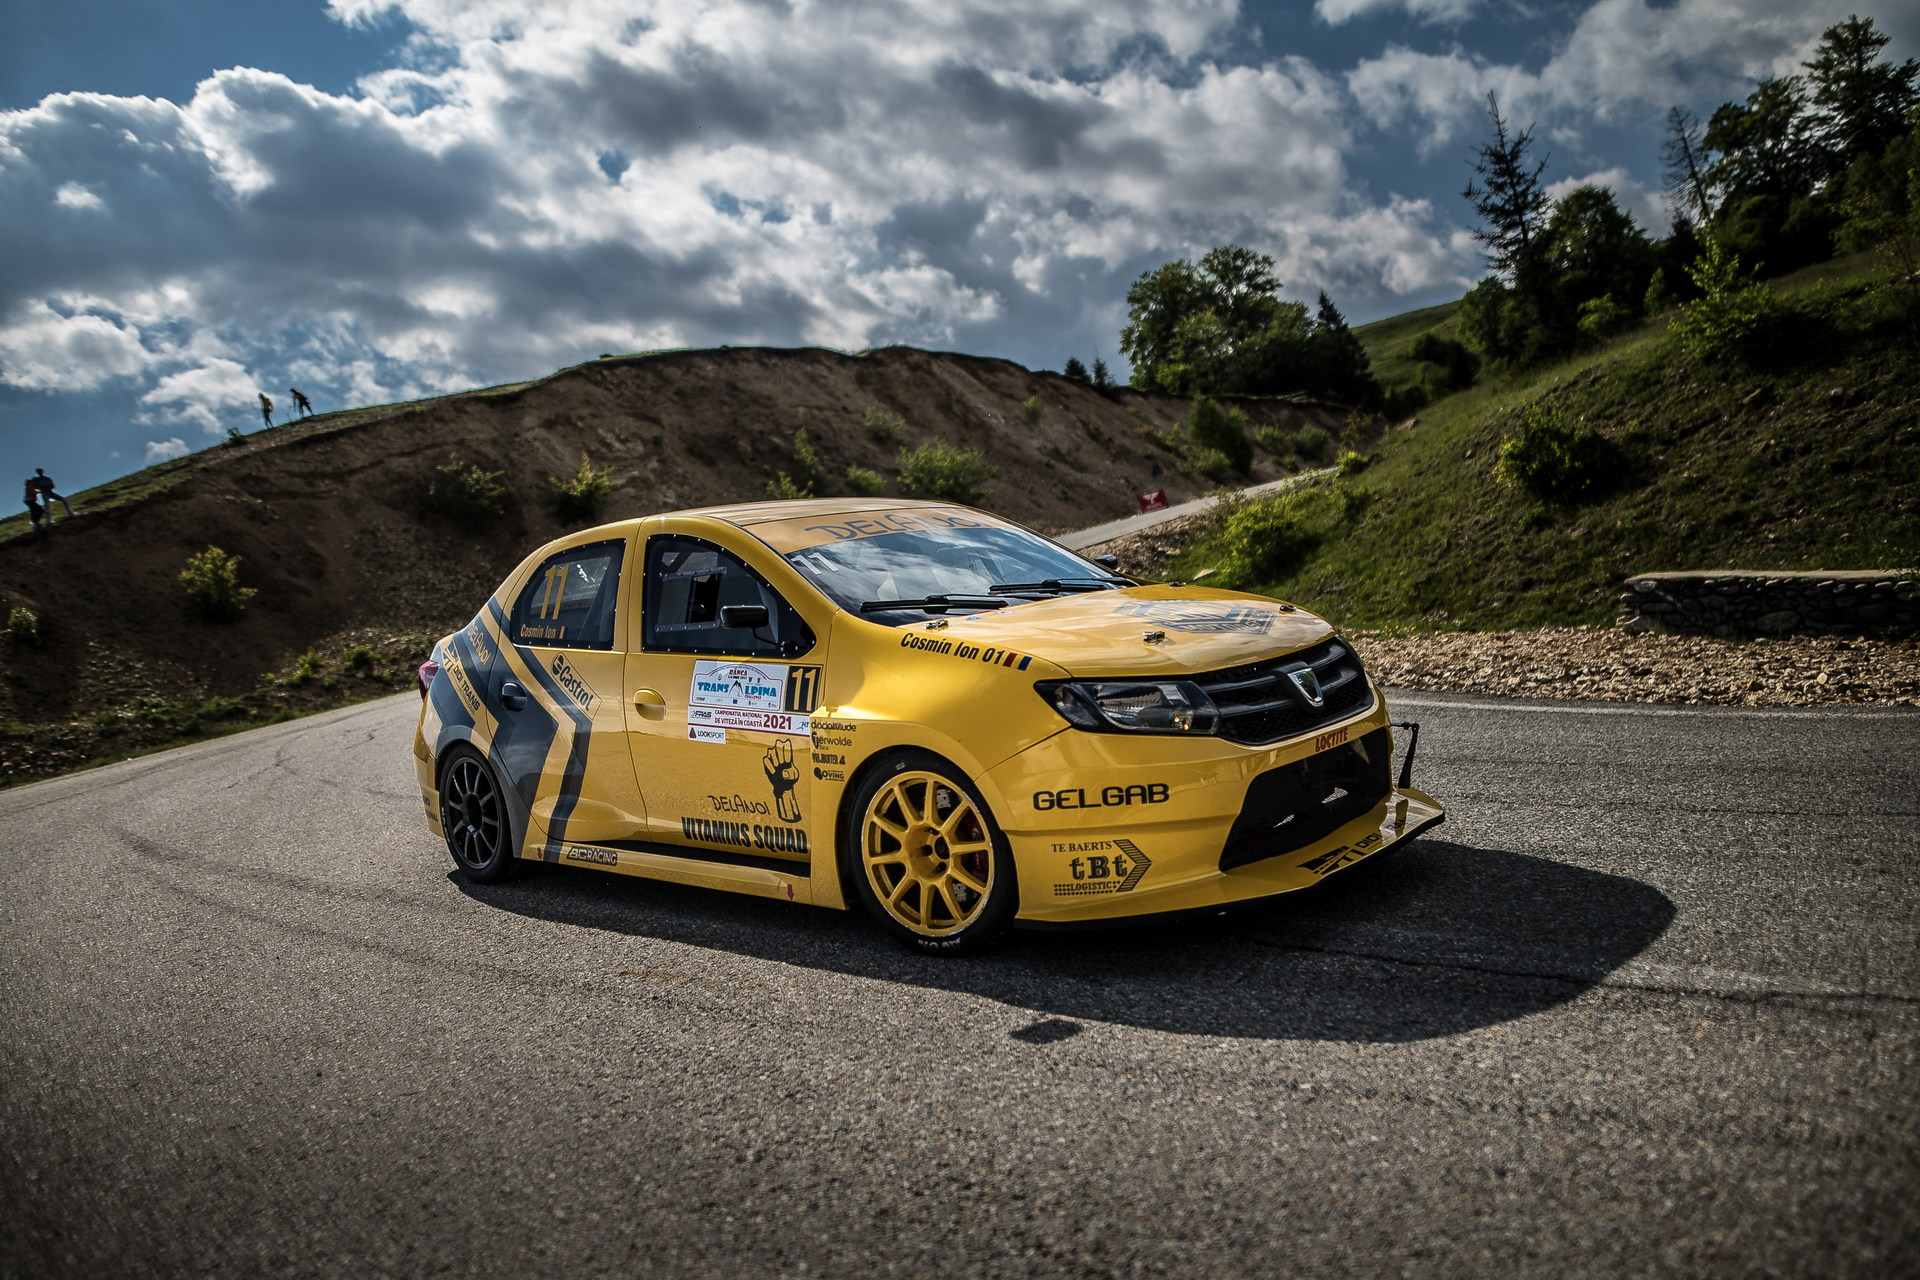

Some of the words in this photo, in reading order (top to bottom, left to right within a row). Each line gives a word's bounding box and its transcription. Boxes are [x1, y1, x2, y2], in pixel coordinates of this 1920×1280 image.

[791, 552, 839, 576] 11
[540, 564, 570, 620] 11
[520, 623, 544, 638] Cosmin
[545, 625, 557, 639] Ion
[900, 633, 952, 655] Cosmin
[953, 642, 980, 660] Ion
[462, 680, 481, 711] TRANS
[559, 665, 594, 711] Castrol
[792, 668, 817, 711] 11
[714, 709, 741, 717] CAMPIONATUL
[763, 714, 792, 730] 2021
[1315, 727, 1348, 752] LOCTITE
[1032, 783, 1170, 811] GELGAB
[681, 816, 752, 848] VITAMINS
[753, 824, 809, 854] SQUAD
[1051, 843, 1067, 853] TE
[1069, 840, 1112, 852] BAERTS
[1070, 880, 1112, 892] LOGISTIC
